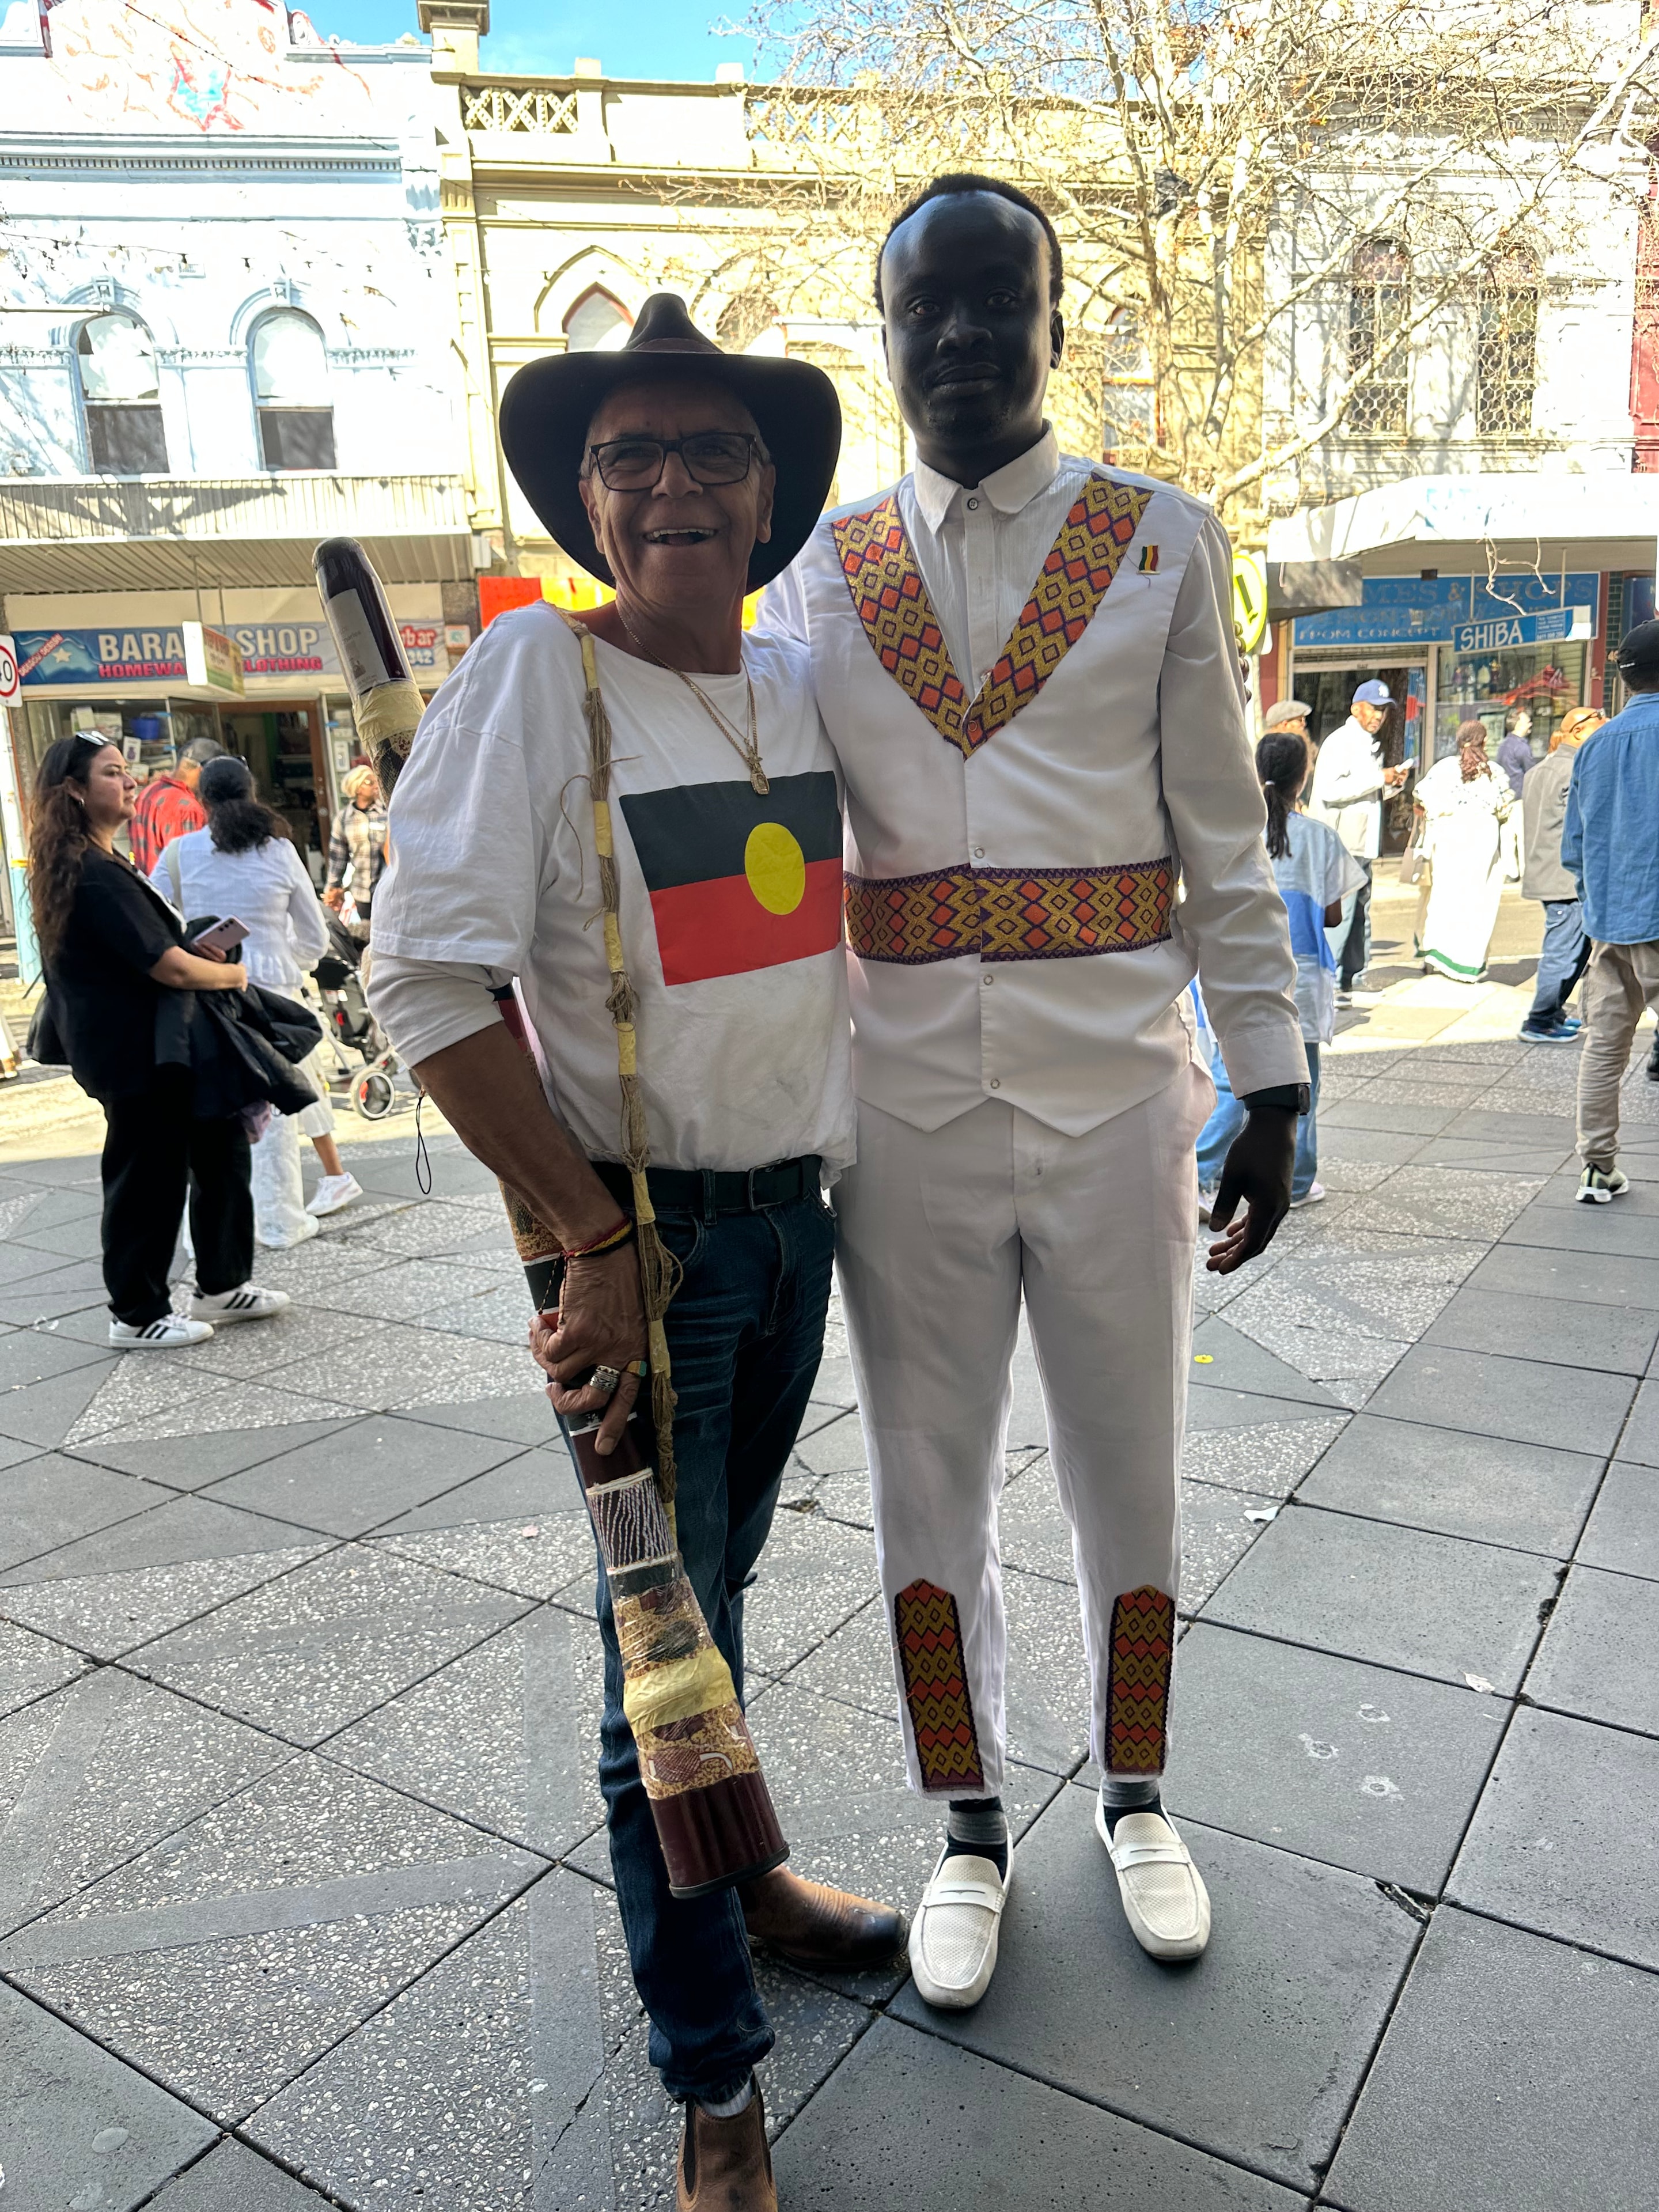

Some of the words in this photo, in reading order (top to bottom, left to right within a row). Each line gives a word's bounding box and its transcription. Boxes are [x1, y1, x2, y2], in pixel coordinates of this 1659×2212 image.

[1363, 583, 1438, 604] MES
[1447, 582, 1465, 602] &
[1475, 578, 1593, 601] SHOPS
[98, 632, 185, 663] BARA
[236, 628, 318, 657] SHOP
[1461, 619, 1522, 652] SHIBA
[0, 660, 13, 683] 0
[99, 662, 187, 678] HOMEWA
